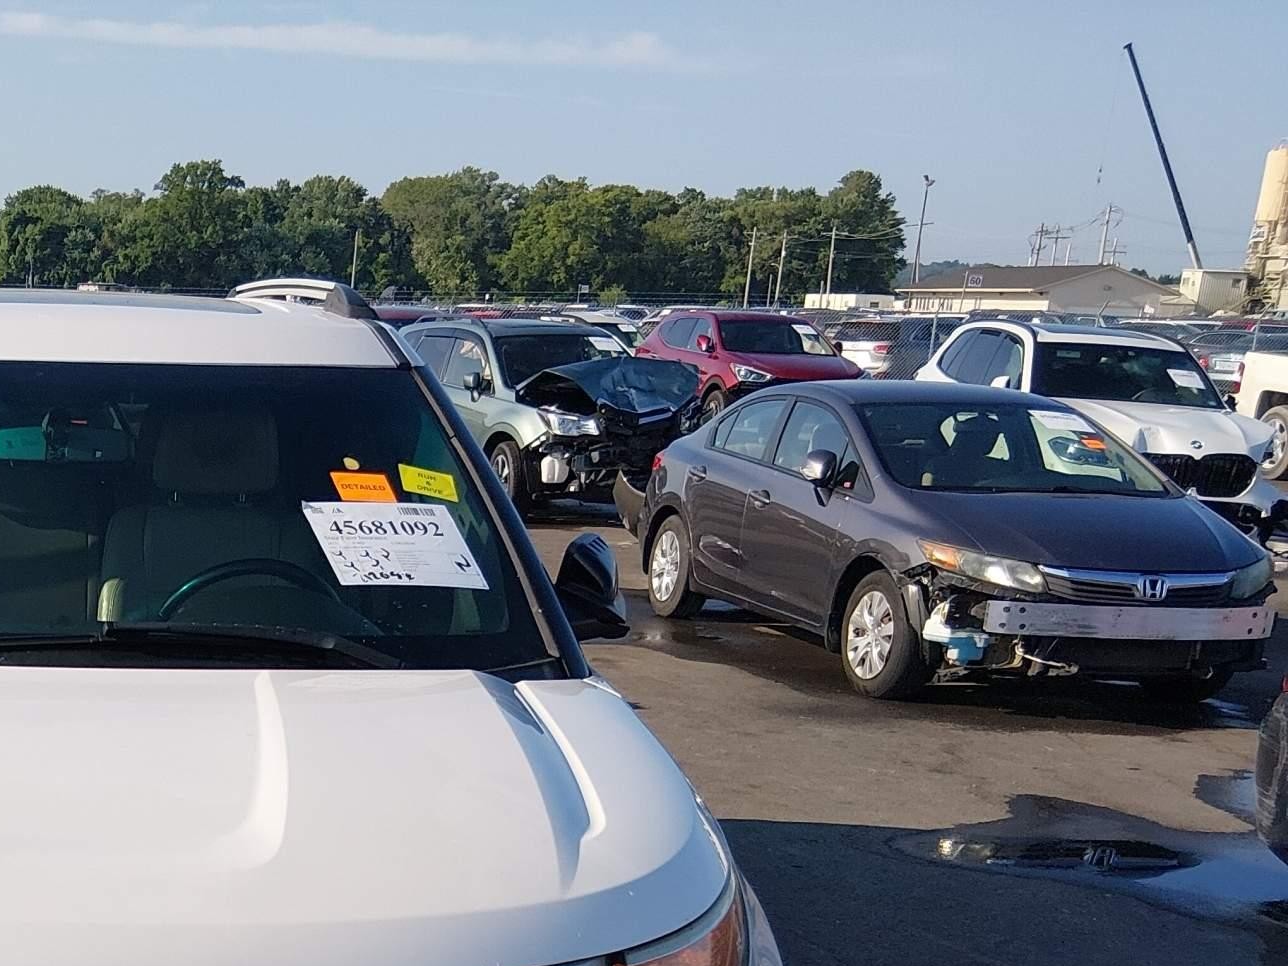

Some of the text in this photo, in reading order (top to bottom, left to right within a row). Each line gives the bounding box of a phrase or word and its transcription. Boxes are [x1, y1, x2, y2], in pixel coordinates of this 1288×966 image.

[969, 276, 981, 286] 60
[417, 472, 437, 482] RUN
[340, 483, 386, 491] DETAILED
[416, 484, 444, 495] DRIVE
[329, 520, 444, 537] 45681092
